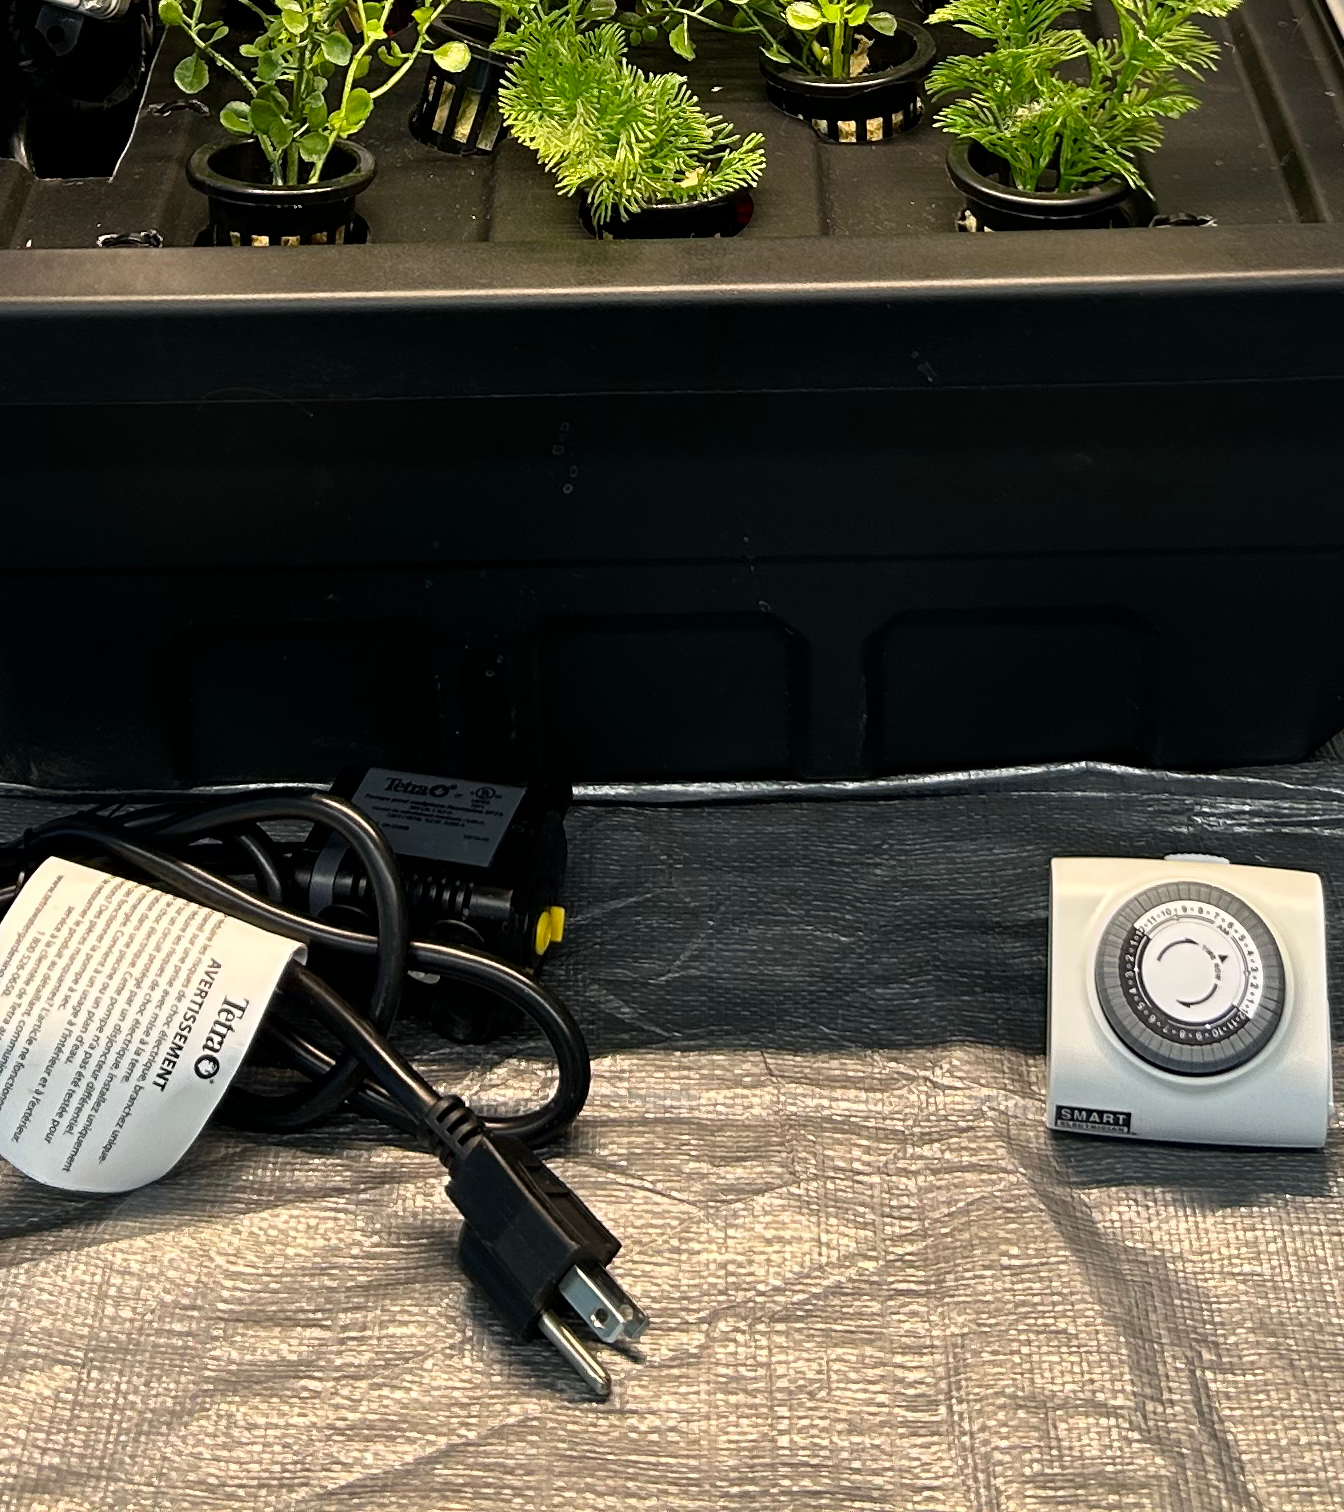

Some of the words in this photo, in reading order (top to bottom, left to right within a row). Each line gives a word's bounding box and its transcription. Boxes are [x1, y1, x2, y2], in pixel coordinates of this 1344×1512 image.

[53, 905, 76, 933] service
[25, 936, 42, 954] 800
[43, 939, 57, 949] la
[49, 932, 60, 940] à
[53, 926, 77, 960] produit
[22, 948, 49, 987] clientèle
[46, 959, 58, 972] au
[105, 948, 128, 982] piscine
[177, 946, 192, 965] une
[71, 952, 94, 986] pompe
[133, 952, 157, 990] protégé
[165, 963, 183, 989] prise
[181, 956, 203, 989] risques
[15, 986, 28, 1001] de
[67, 985, 78, 993] à
[85, 974, 98, 989] un
[98, 981, 110, 996] ou
[147, 978, 160, 992] de
[70, 988, 90, 1019] usage
[91, 995, 103, 1010] un
[124, 989, 138, 1008] par
[135, 992, 153, 1018] choc
[154, 988, 170, 1012] avec
[174, 989, 187, 1004] de
[2, 1001, 23, 1025] Tetra
[66, 1018, 78, 1027] à
[79, 1009, 96, 1034] plan
[95, 995, 118, 1034] pompe
[117, 1007, 129, 1023] un
[142, 1011, 160, 1038] mise
[152, 957, 222, 1093] AVERTISSEMENT
[162, 1003, 179, 1030] choc
[17, 1046, 30, 1061] ne
[90, 1022, 123, 1082] disjoncteur
[109, 1017, 142, 1071] électrique,
[133, 1046, 146, 1057] la
[138, 1037, 150, 1046] à
[78, 1049, 93, 1071] pas
[37, 1076, 48, 1089] et
[70, 1070, 86, 1089] été
[32, 1088, 45, 1096] à
[54, 1088, 77, 1119] testée
[90, 1072, 118, 1114] installez
[114, 1084, 145, 1130] branchez
[1061, 1108, 1127, 1124] SMART
[43, 1118, 61, 1144] pour
[61, 1113, 96, 1173] uniquement
